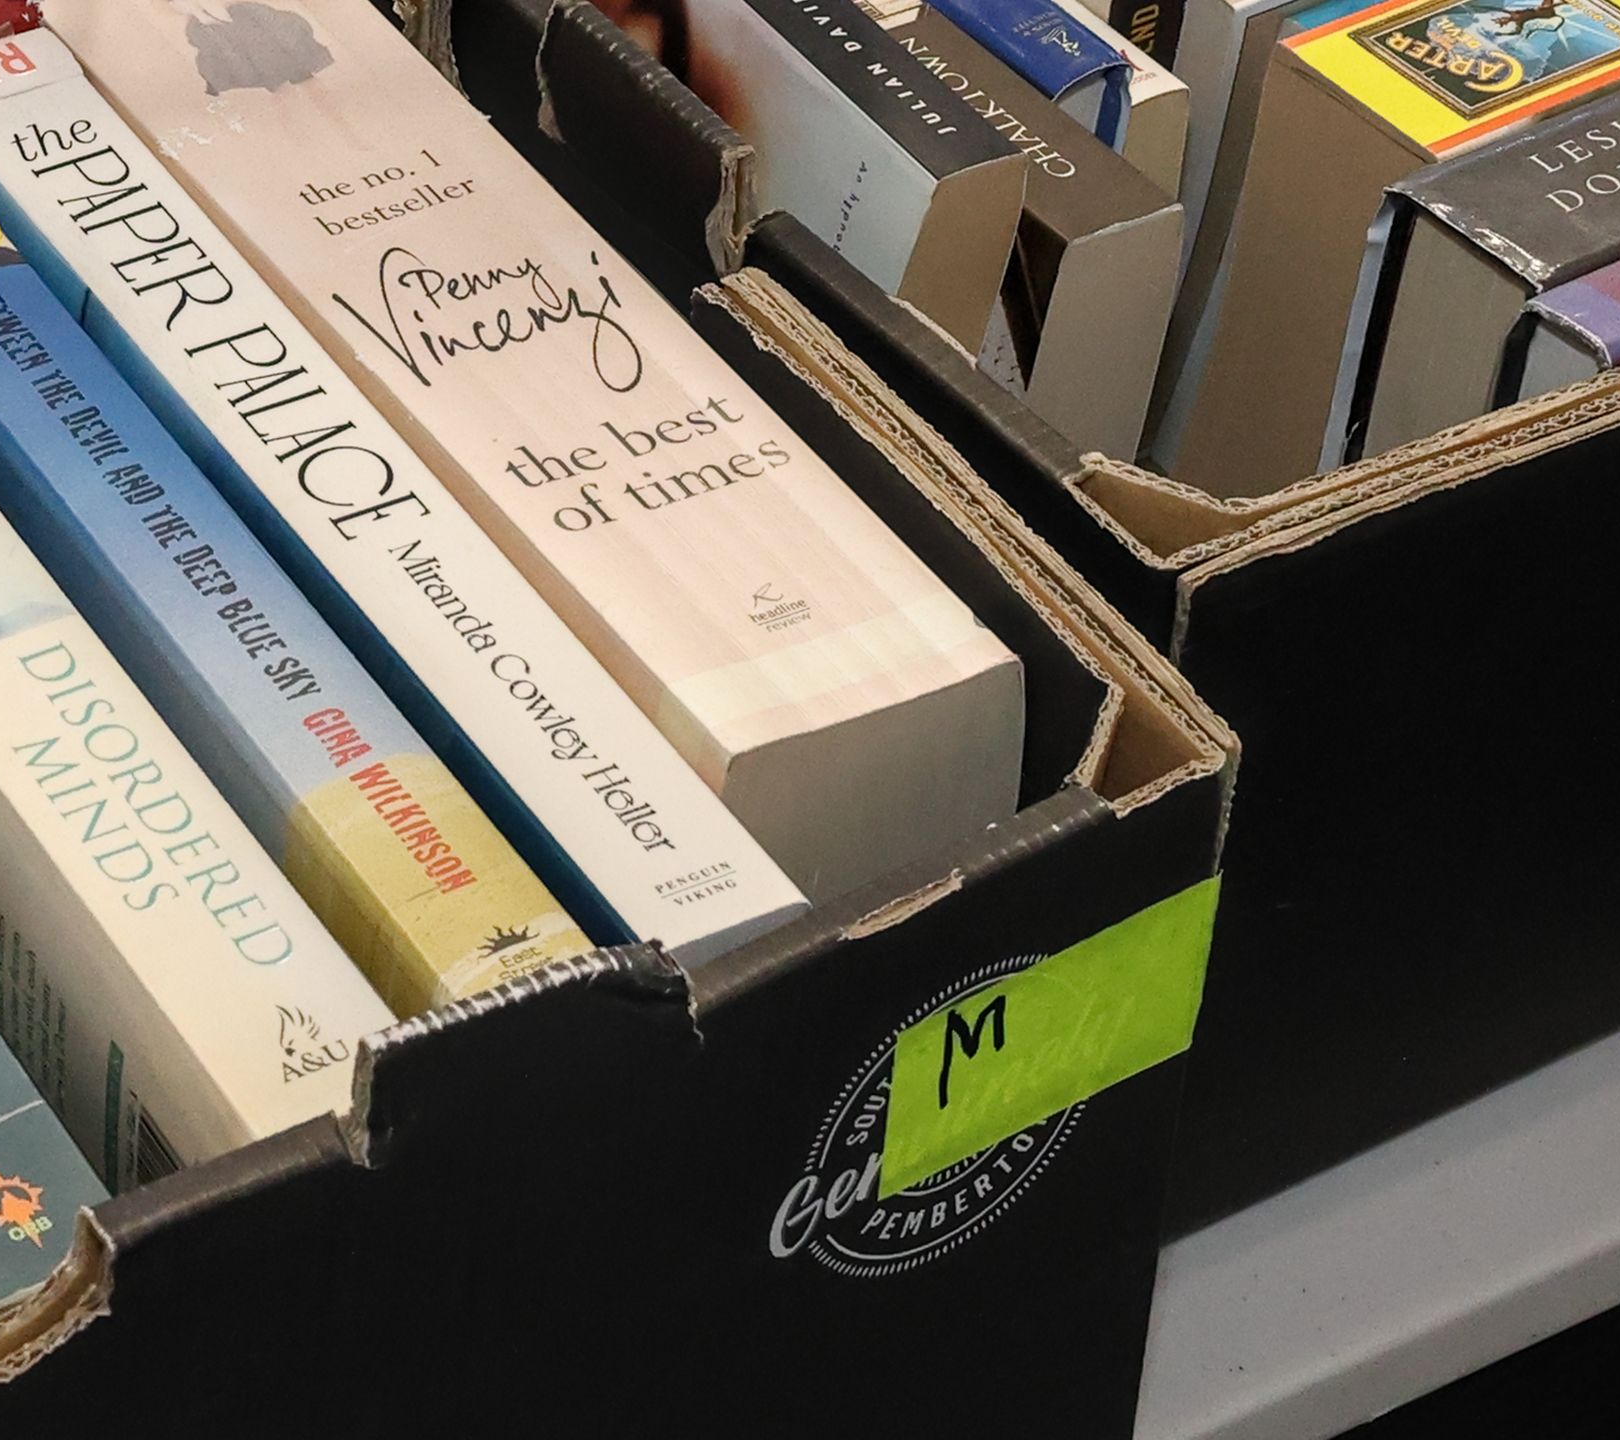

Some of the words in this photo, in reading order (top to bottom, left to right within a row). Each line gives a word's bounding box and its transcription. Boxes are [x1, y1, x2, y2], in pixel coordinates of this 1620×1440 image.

[10, 116, 99, 165] the
[298, 175, 355, 210] the
[359, 163, 419, 196] no.
[429, 149, 443, 174] 1
[316, 174, 478, 239] bestseller
[503, 439, 609, 490] the
[614, 390, 746, 455] best
[552, 481, 618, 536] of
[624, 437, 794, 515] times
[29, 145, 235, 332] PAPER
[183, 322, 433, 543] PALACE
[387, 537, 500, 658] Miranda
[489, 651, 600, 768] Cowley
[581, 759, 678, 856] Heller
[12, 738, 182, 912] MINDS
[18, 639, 297, 968] DISORDERED
[653, 859, 733, 898] PENGUIN
[672, 876, 739, 909] VIKING
[938, 995, 1008, 1110] M
